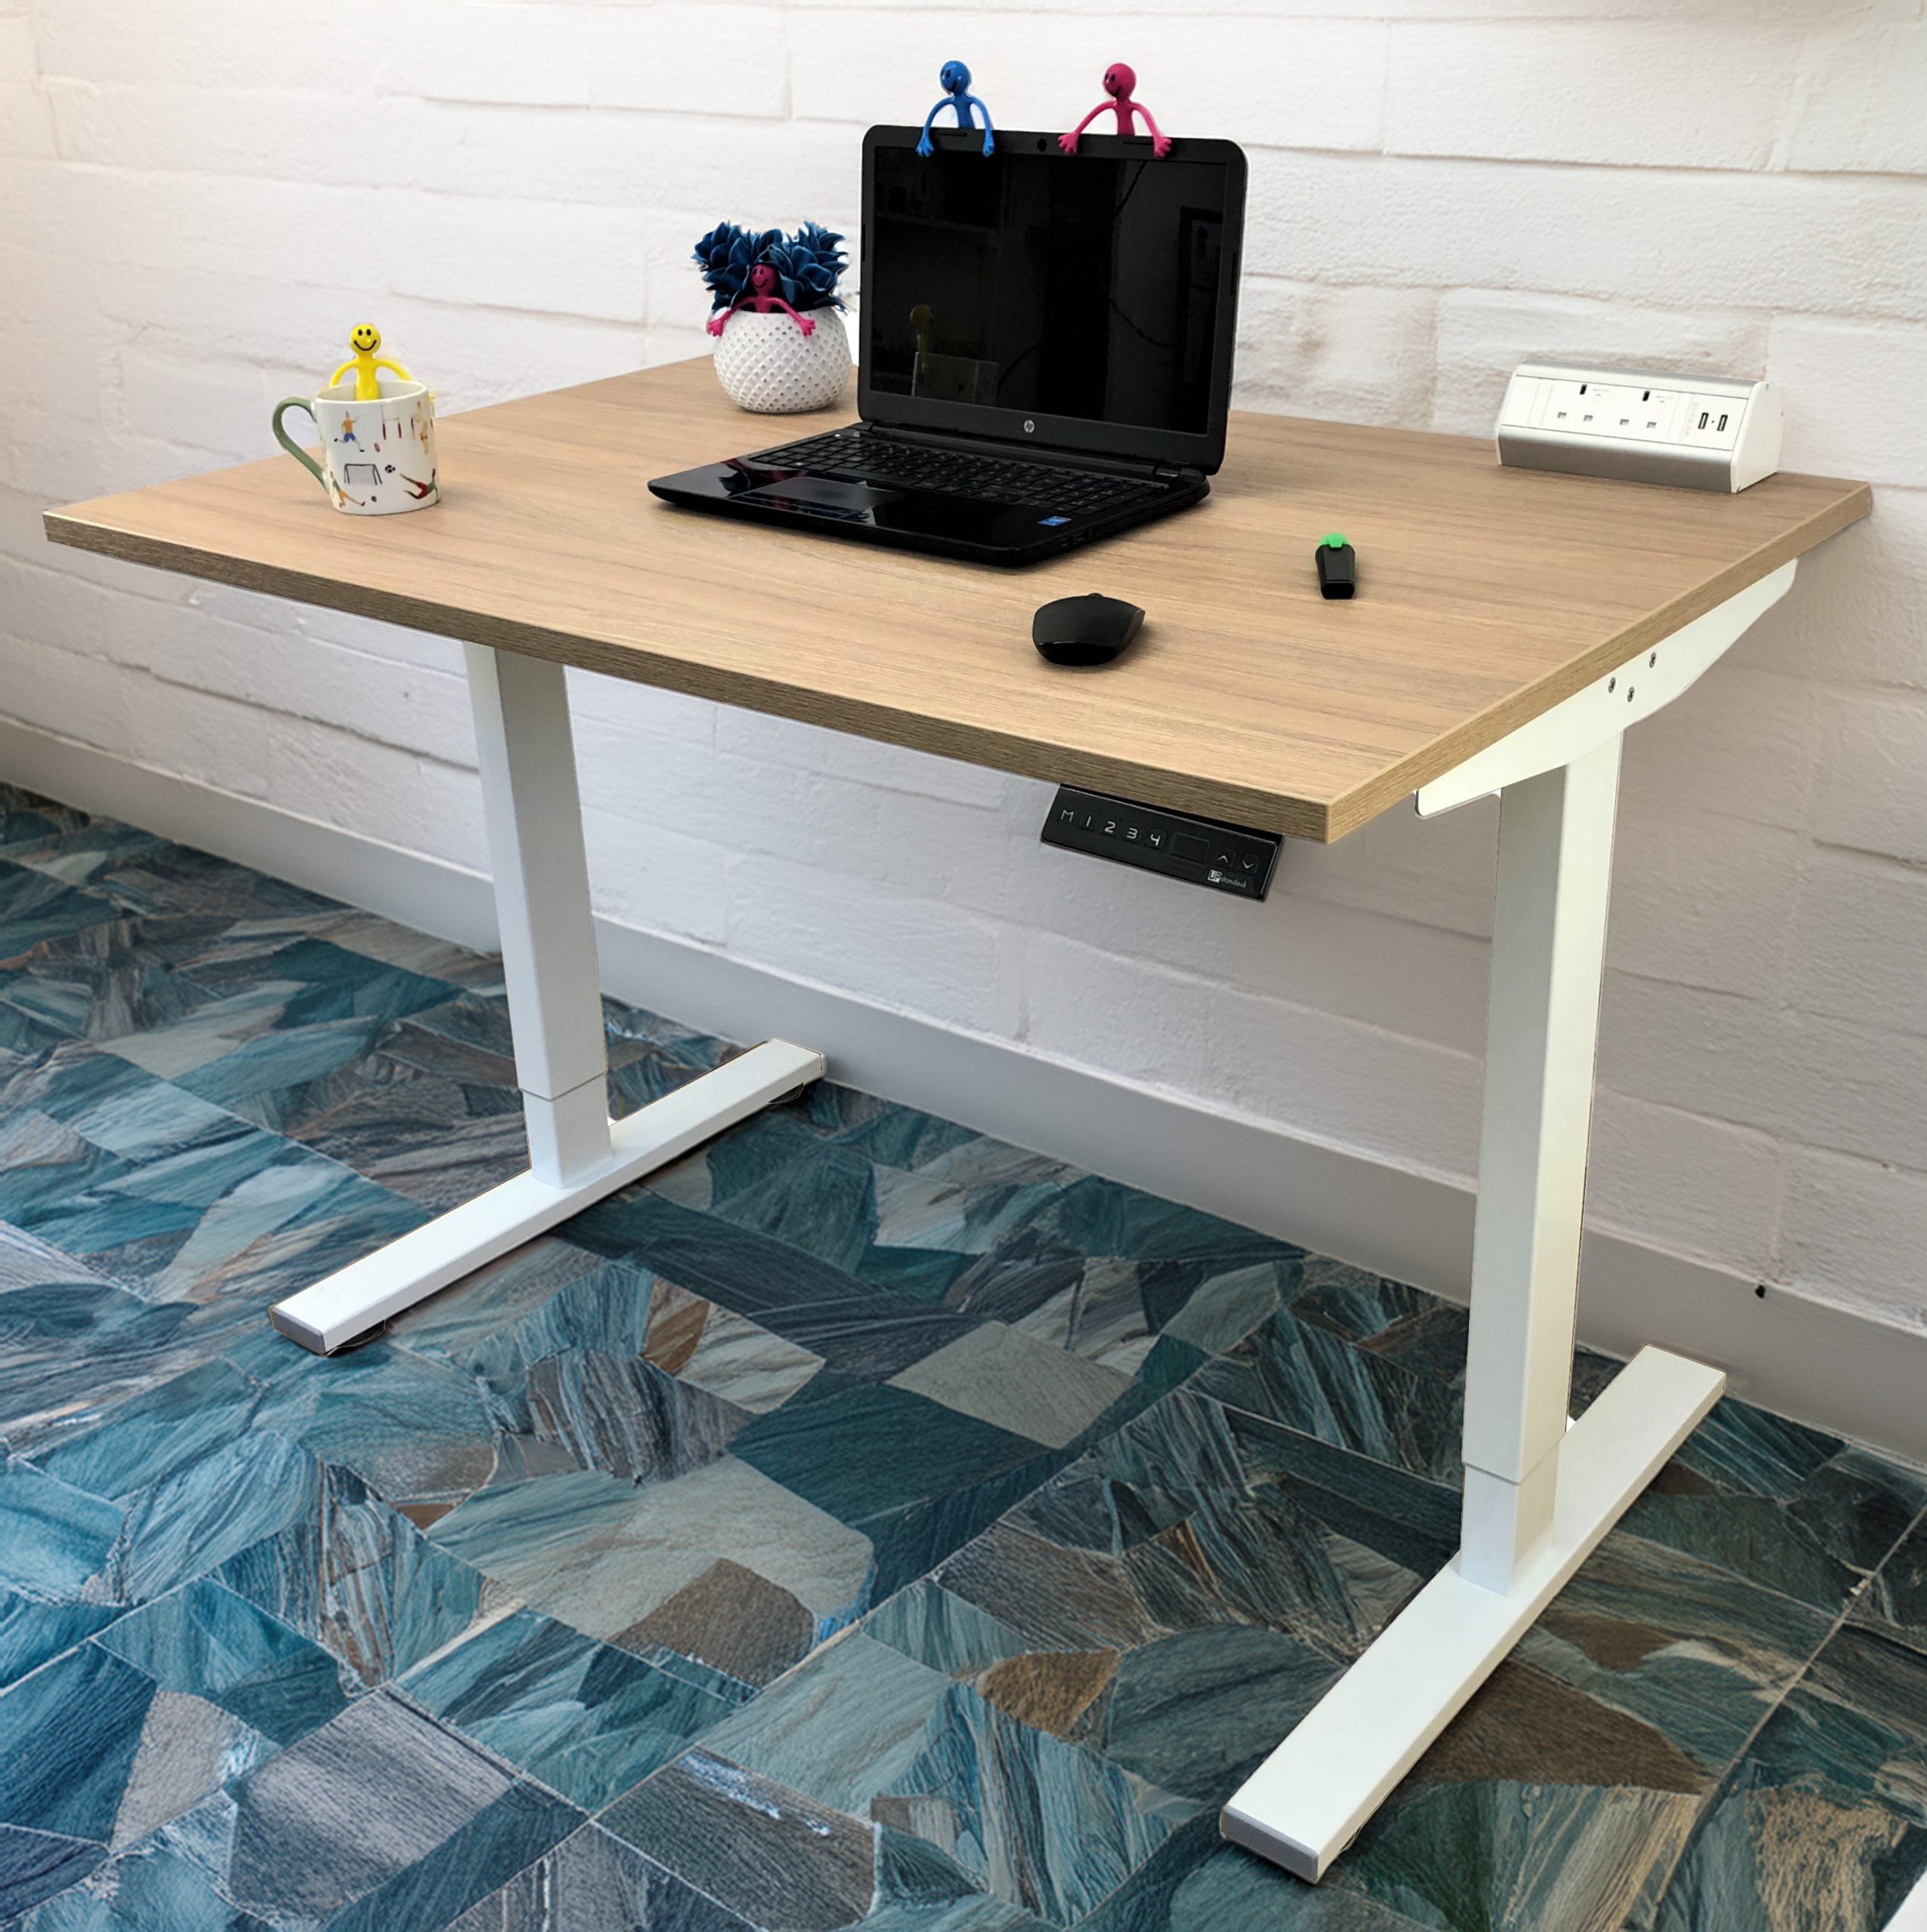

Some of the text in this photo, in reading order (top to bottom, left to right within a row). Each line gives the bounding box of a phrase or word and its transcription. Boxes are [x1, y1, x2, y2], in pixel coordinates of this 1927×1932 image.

[1024, 420, 1034, 433] hp
[1061, 809, 1074, 822] M
[1104, 820, 1116, 833] 2
[1126, 827, 1138, 839] 3
[1150, 834, 1160, 846] 4
